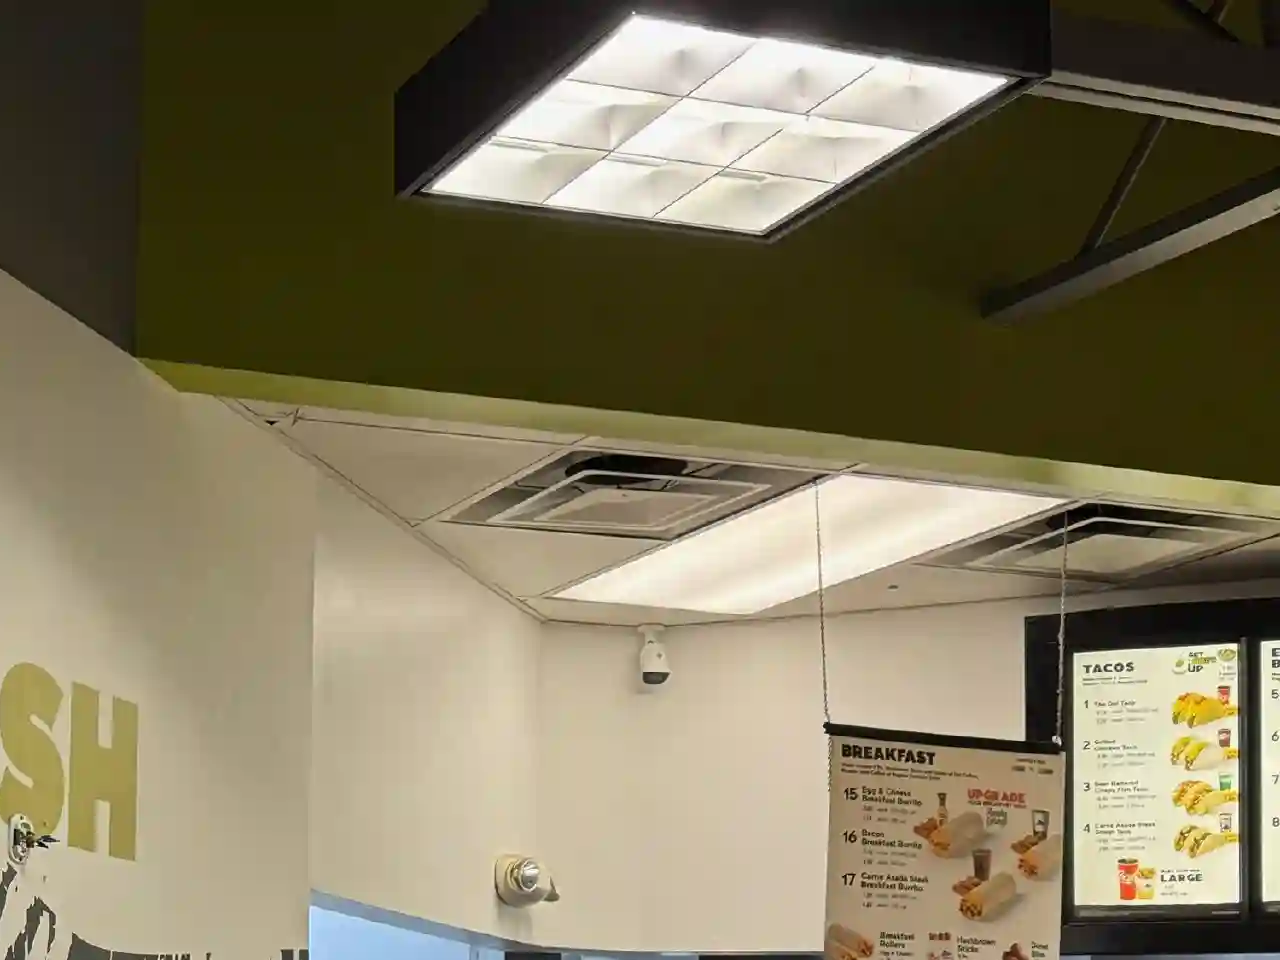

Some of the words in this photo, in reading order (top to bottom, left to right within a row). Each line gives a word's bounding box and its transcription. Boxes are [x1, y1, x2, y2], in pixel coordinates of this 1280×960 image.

[1082, 662, 1135, 674] TACOS
[1188, 664, 1204, 673] UP
[1271, 688, 1279, 699] 5
[1083, 699, 1089, 709] 1
[1271, 731, 1280, 742] 6
[1083, 740, 1091, 750] 2
[841, 743, 937, 766] BREAKFAST
[1271, 774, 1280, 785] 7
[1083, 782, 1091, 792] 3
[843, 787, 859, 801] 15
[862, 785, 877, 796] Egg
[967, 787, 1027, 803] UPGRADE
[1083, 823, 1091, 834] 4
[842, 829, 858, 844] 16
[862, 828, 885, 838] Bacon
[841, 872, 857, 886] 17
[1160, 873, 1203, 883] LARGE
[898, 882, 924, 892] Burrito
